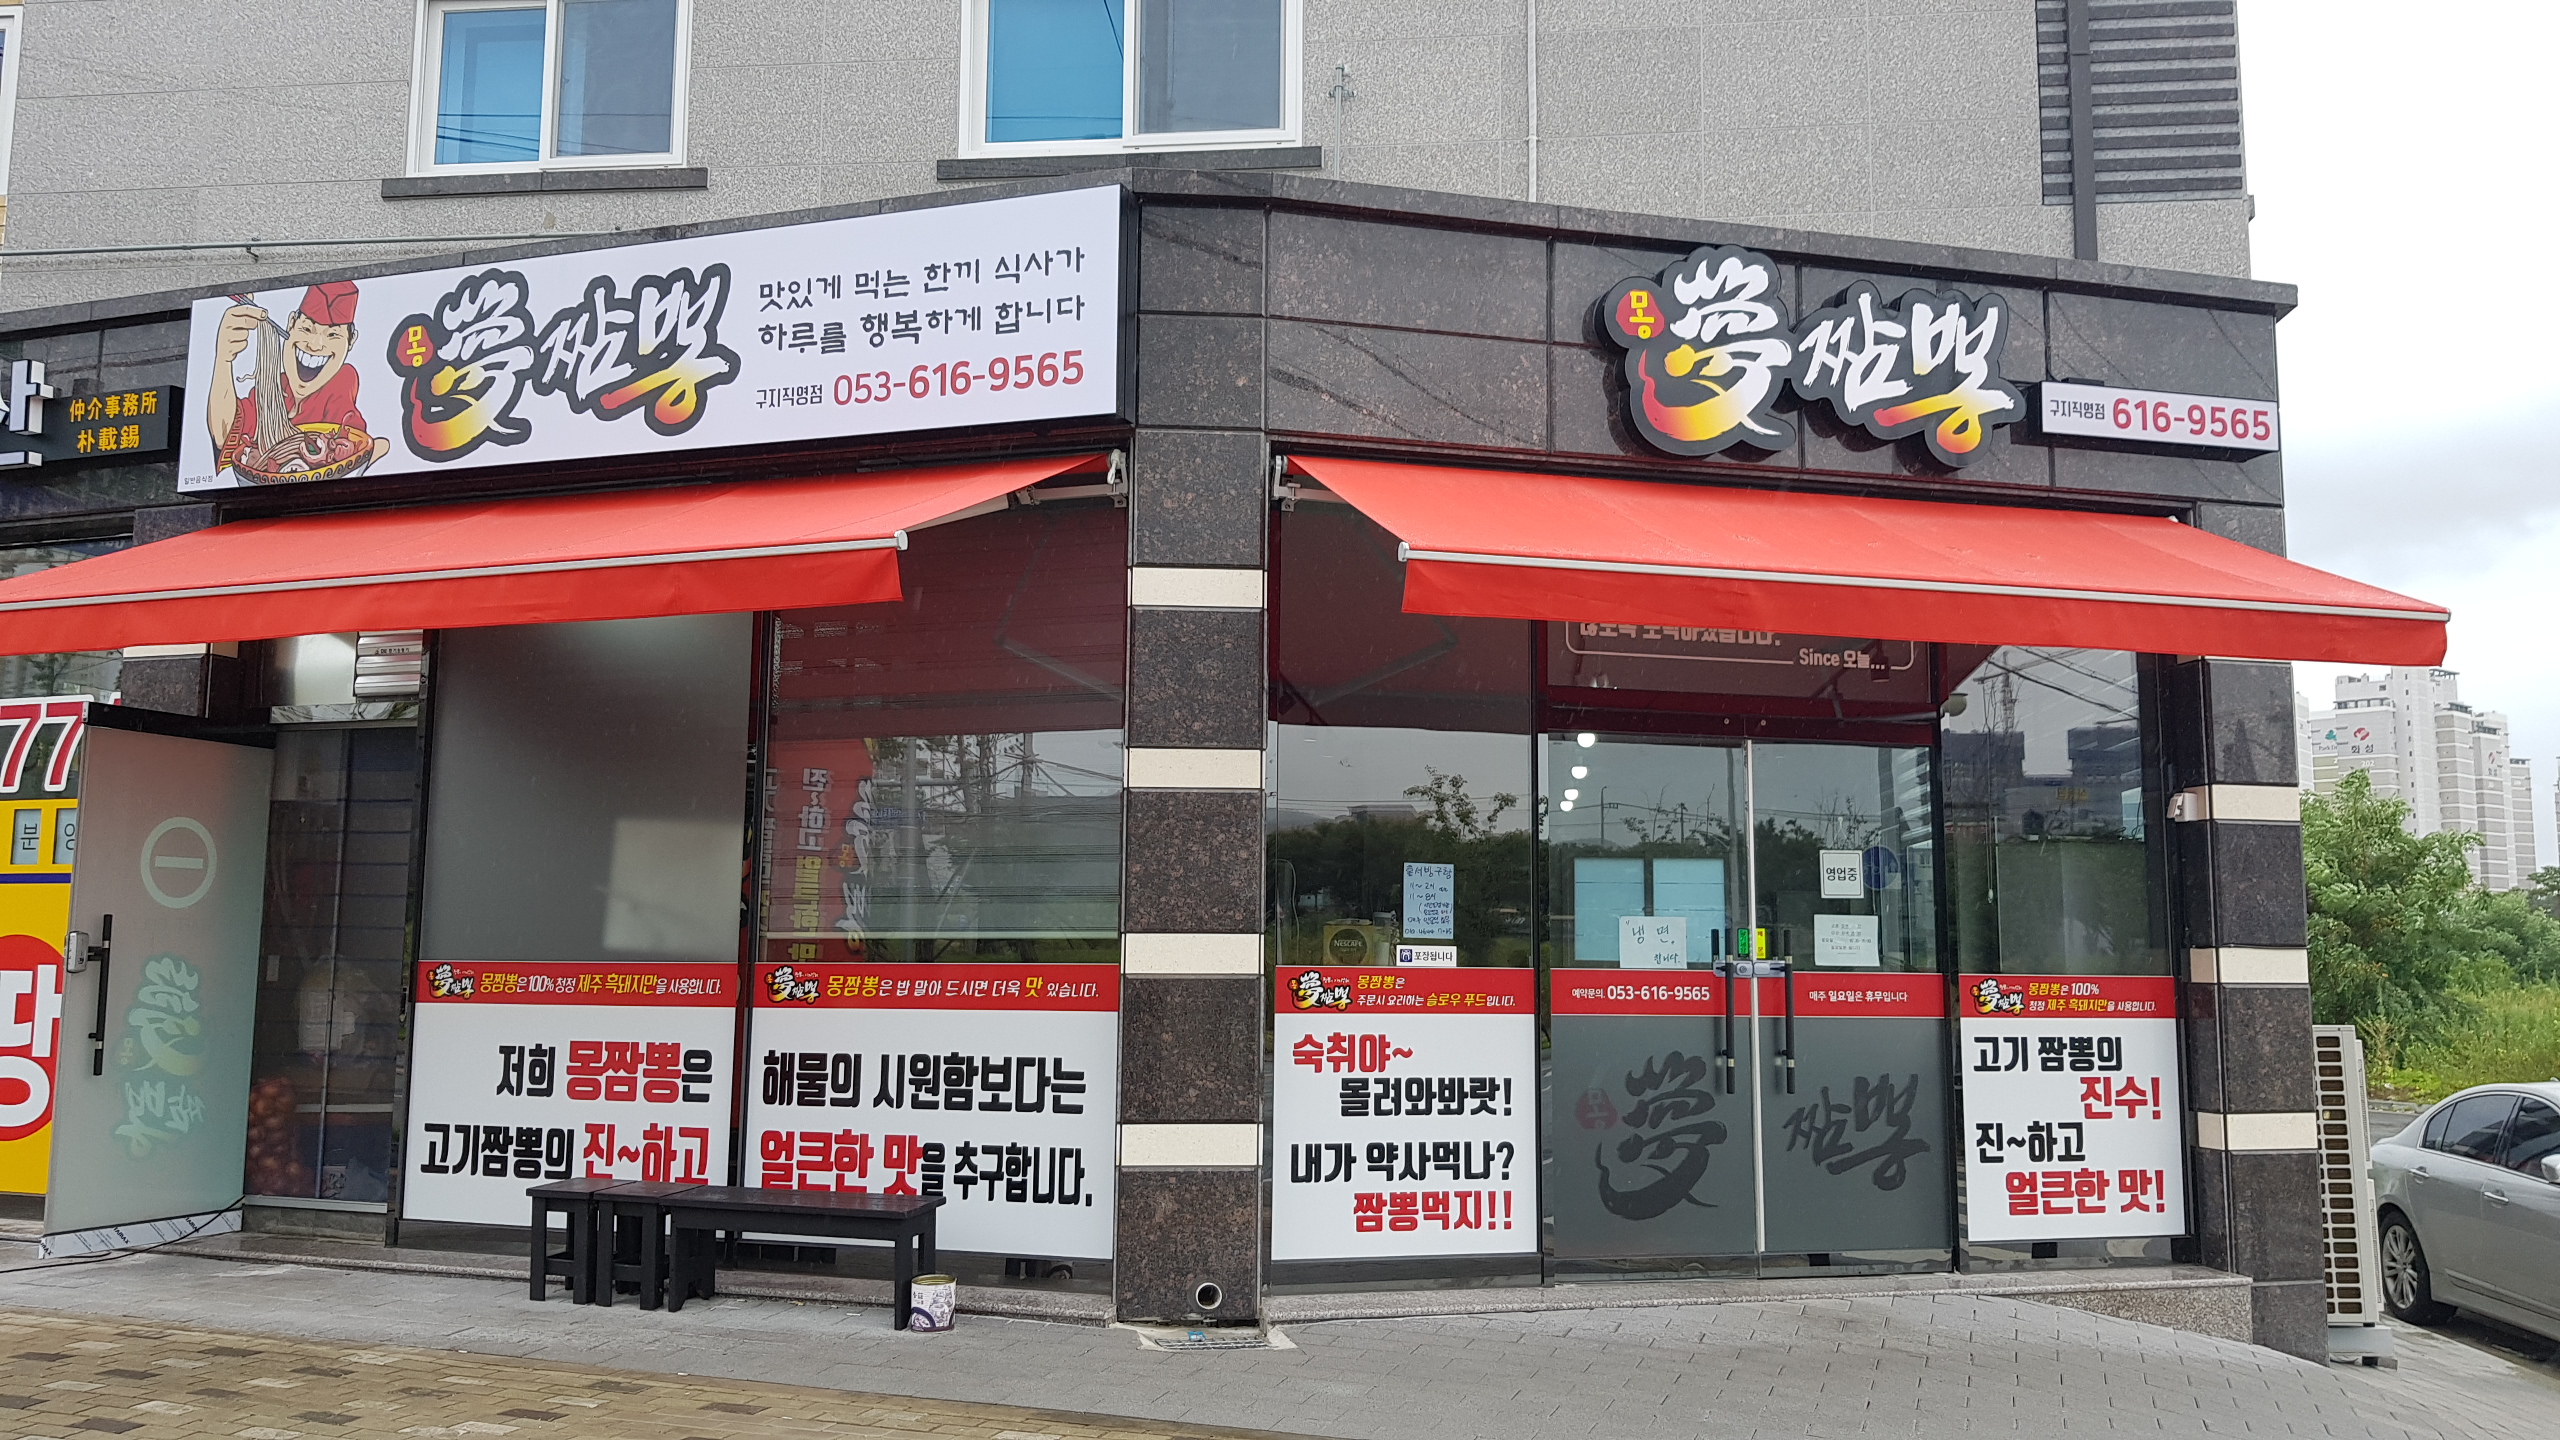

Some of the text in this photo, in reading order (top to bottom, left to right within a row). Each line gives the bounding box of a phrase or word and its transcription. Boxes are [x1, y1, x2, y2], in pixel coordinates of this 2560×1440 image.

[760, 247, 1085, 312] 맛있게 먹는 한끼 식사가
[757, 295, 1085, 354] 하루를 행복하게 합니다
[756, 349, 1084, 409] 구지직영점 053-616-9565
[70, 390, 158, 422] 仲介事務所
[2049, 397, 2271, 441] 구지직영점 616-9565
[1800, 648, 1840, 666] Since
[1826, 867, 1858, 882] 영업중
[1414, 951, 1453, 962] 포장됩니다
[480, 973, 722, 995] 몽짬뽕은 100% 청정 제주 흑돼지만을 사용합니다.
[826, 976, 1100, 999] 몽짬뽕은 밥 말아 드시면 더욱 맛 있습니다.
[1357, 975, 1406, 989] 몽짬뽕은
[1357, 993, 1516, 1006] 주문시 요리하는 슬로우 푸드입니다.
[1571, 985, 1710, 1001] 예약문의. 053-616-9565
[1809, 991, 1908, 1002] 매주 일요일은 휴무입니다
[2029, 982, 2069, 996] 몽짬뽕은
[2071, 983, 2099, 996] 100%
[2029, 999, 2157, 1012] 청정 제주 흑돼지만을 사용합니다.
[496, 1040, 713, 1103] 저희 몽짬뽕은
[1293, 1032, 1413, 1073] 숙취야~
[1973, 1036, 2123, 1072] 고기 짬뽕의
[762, 1050, 1086, 1115] 해물의 시원함보다는
[1339, 1077, 1512, 1117] 몰려와봐랏!
[2080, 1076, 2161, 1120] 진수!
[420, 1123, 710, 1185] 고기짬뽕의 진~하고
[1290, 1141, 1515, 1183] 내가 약사먹나?
[1976, 1121, 2086, 1164] 진~하고
[760, 1129, 1093, 1207] 얼큰한 맛을 추구합니다.
[1353, 1190, 1512, 1232] 짬뽕먹지!!
[2006, 1168, 2165, 1216] 얼큰한 맛!
